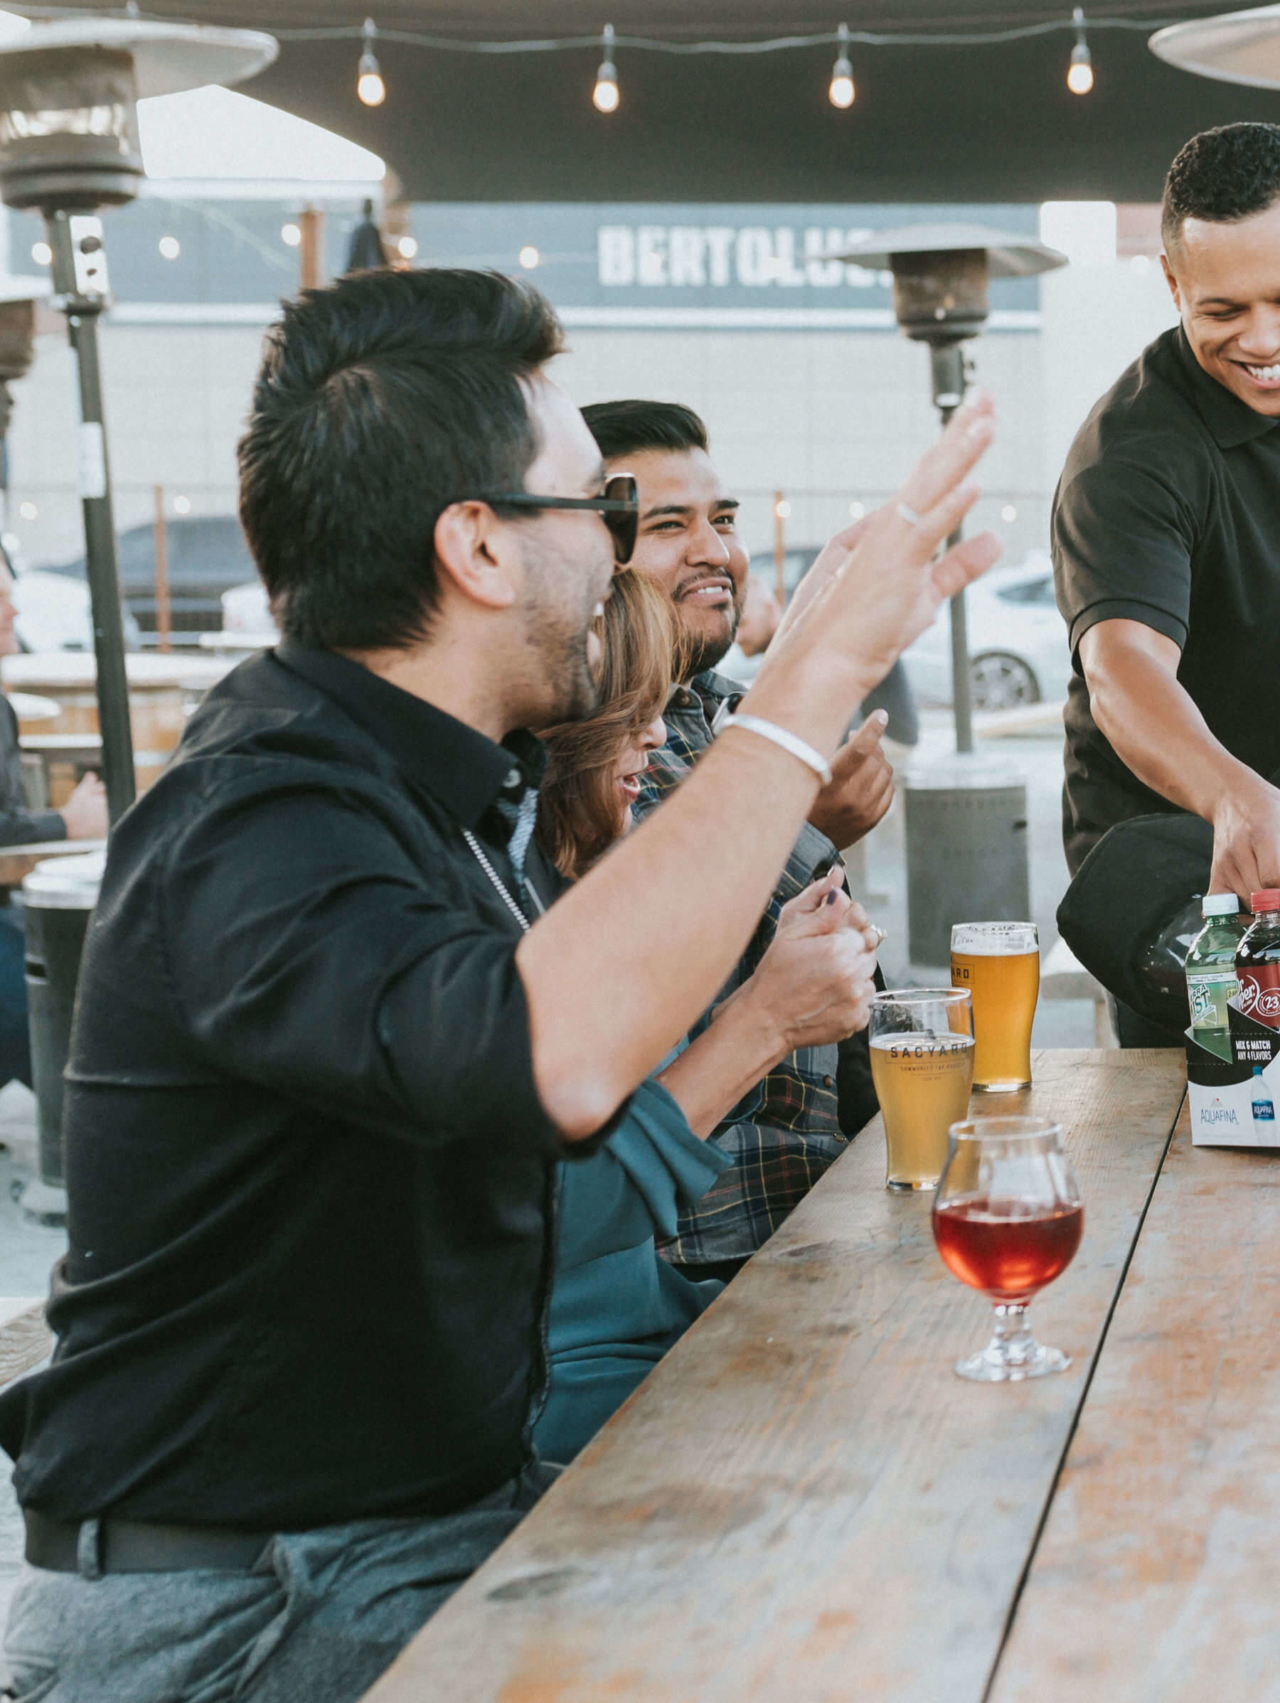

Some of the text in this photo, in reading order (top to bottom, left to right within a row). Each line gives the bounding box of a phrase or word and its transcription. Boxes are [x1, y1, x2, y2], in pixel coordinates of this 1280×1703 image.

[1264, 995, 1280, 1010] 23
[890, 1042, 967, 1058] SACYARD
[1235, 1040, 1246, 1050] MIX
[1250, 1040, 1271, 1050] MATCH
[1237, 1051, 1247, 1061] ANY
[1250, 1051, 1272, 1061] FLAVORS
[1200, 1108, 1237, 1125] AQUAFINA
